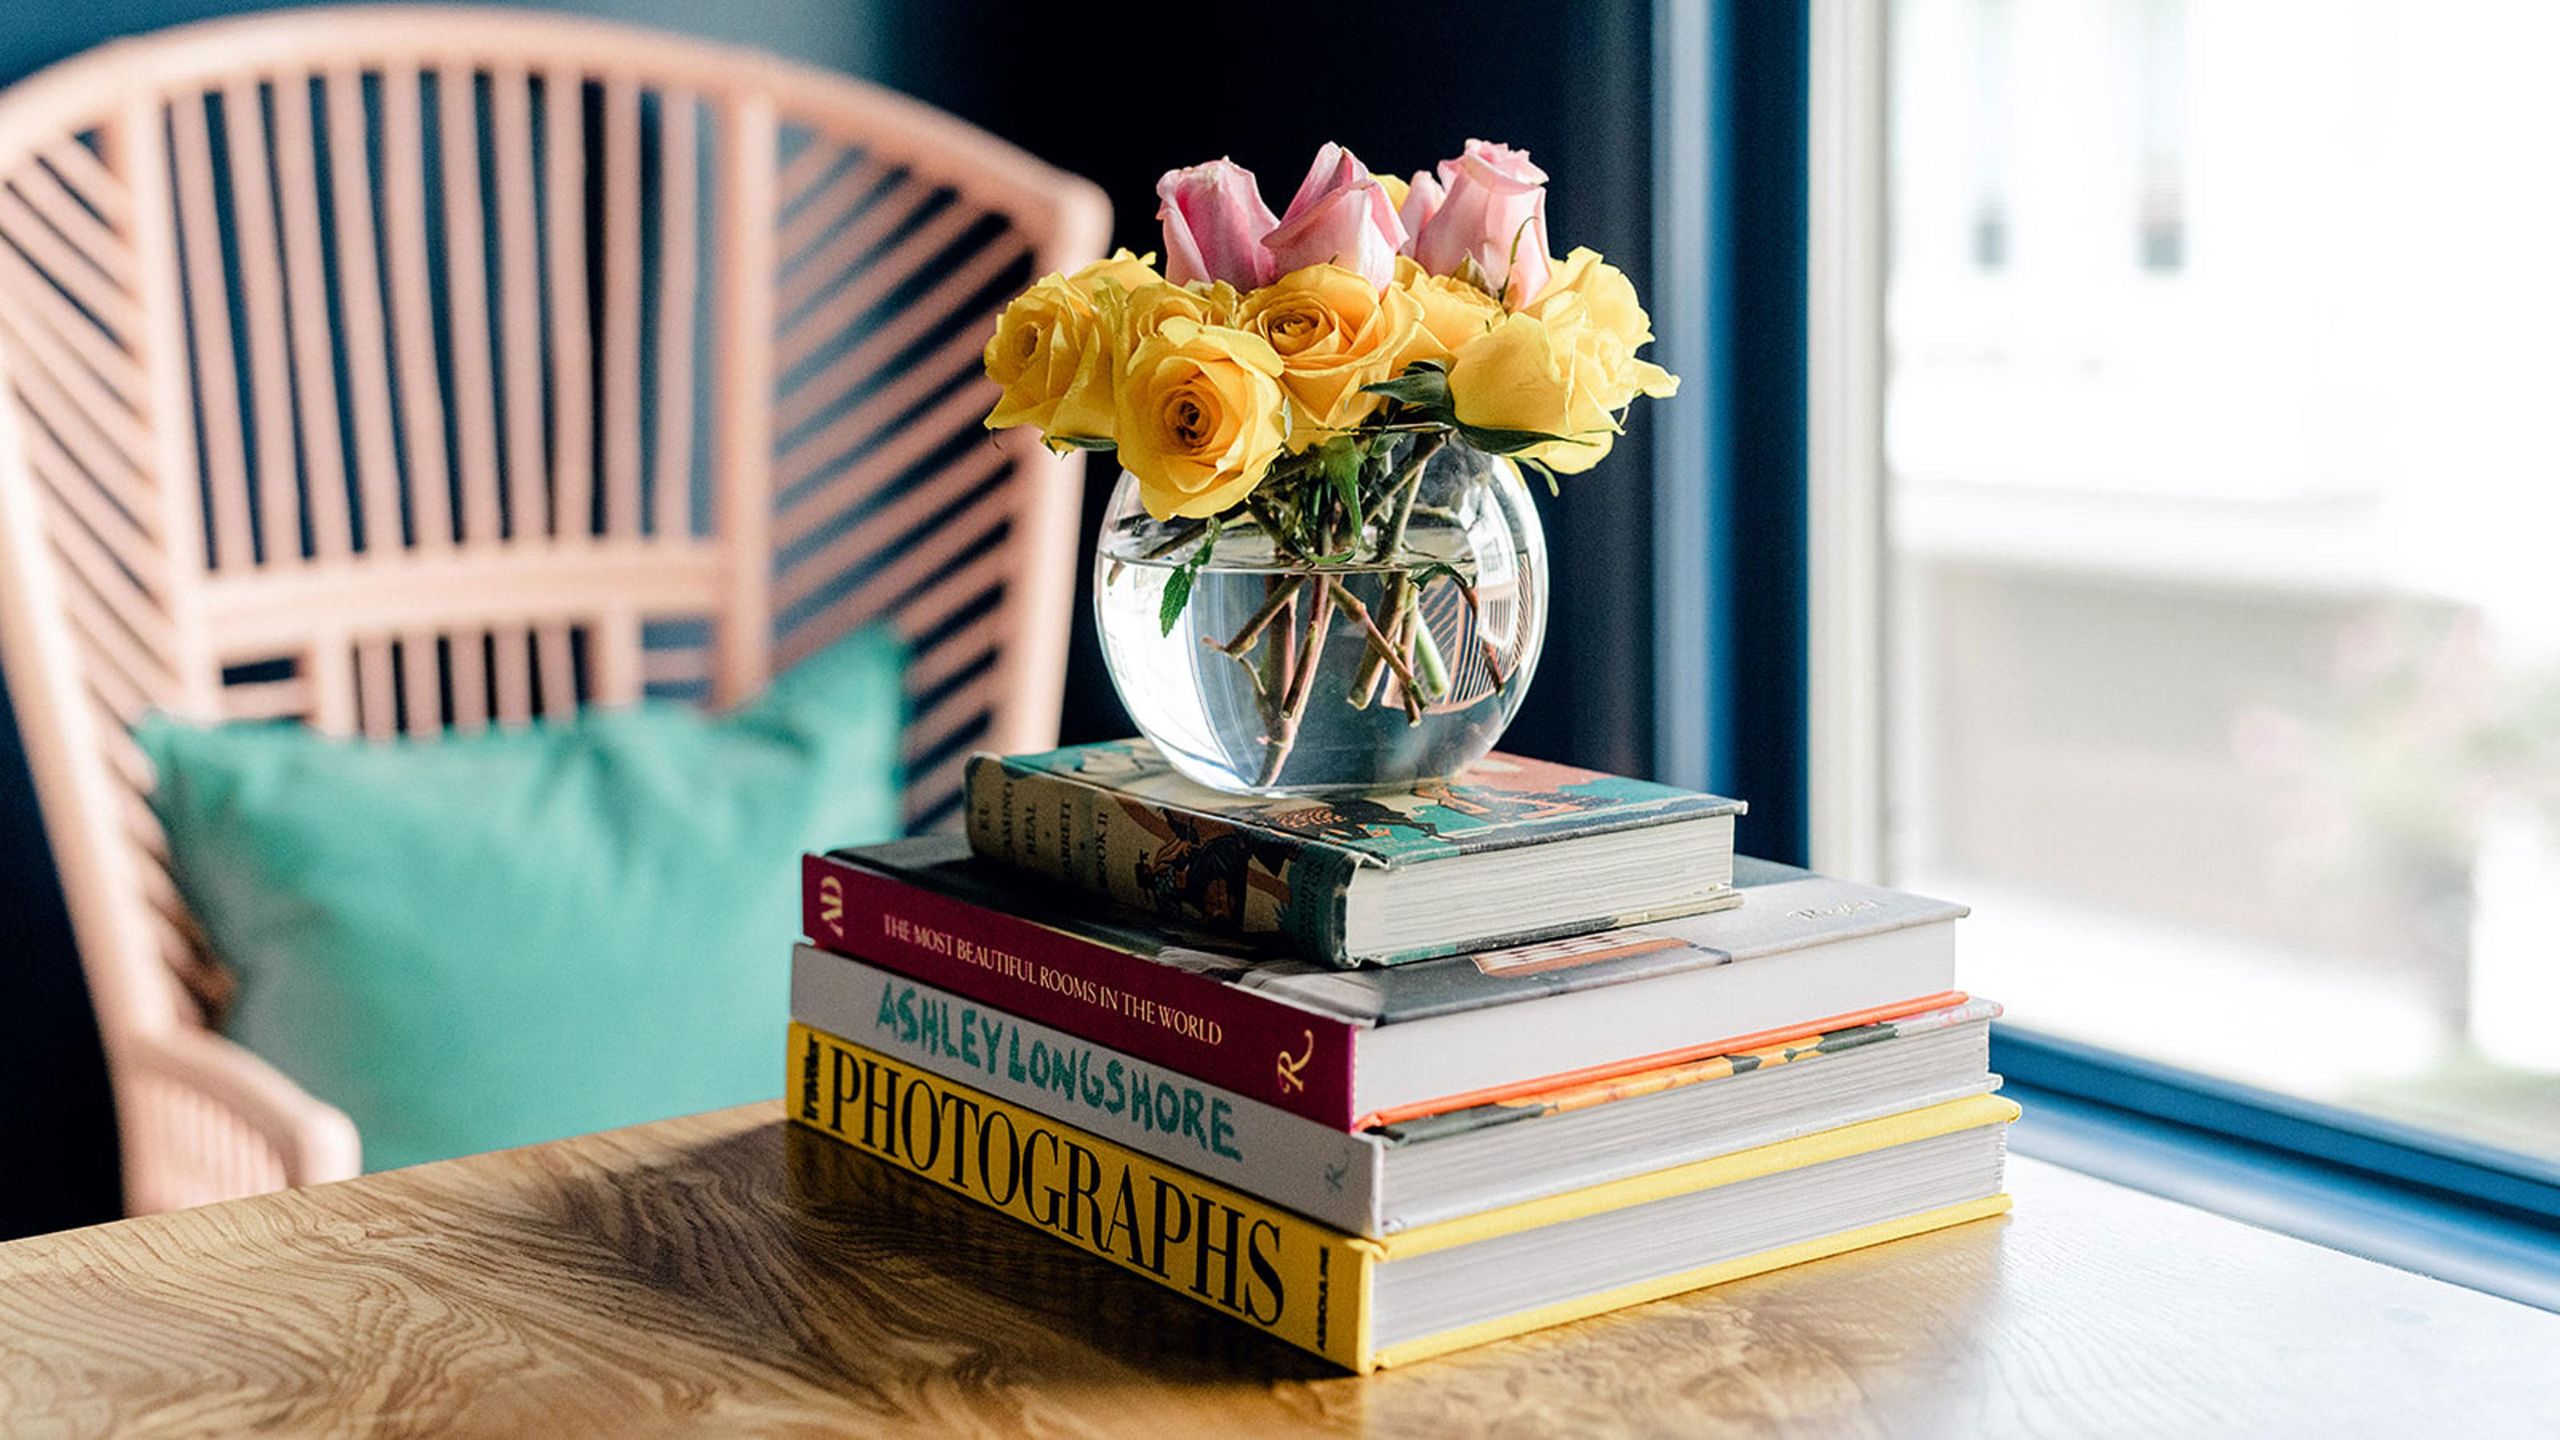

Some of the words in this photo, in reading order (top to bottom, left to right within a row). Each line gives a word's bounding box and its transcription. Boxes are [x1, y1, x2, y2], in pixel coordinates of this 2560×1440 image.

[820, 875, 844, 937] AD
[883, 913, 913, 944] THE
[913, 924, 953, 956] MOST
[956, 937, 1037, 985] BEAUTIFUL
[1039, 964, 1097, 1004] ROOMS
[1099, 985, 1118, 1011] IN
[1121, 991, 1156, 1025] THE
[1158, 1003, 1222, 1046] WORLD
[876, 980, 1003, 1075] ASHLEY
[1007, 1025, 1243, 1163] LONGSHORE
[828, 1045, 1285, 1327] PHOTOGRAPHS
